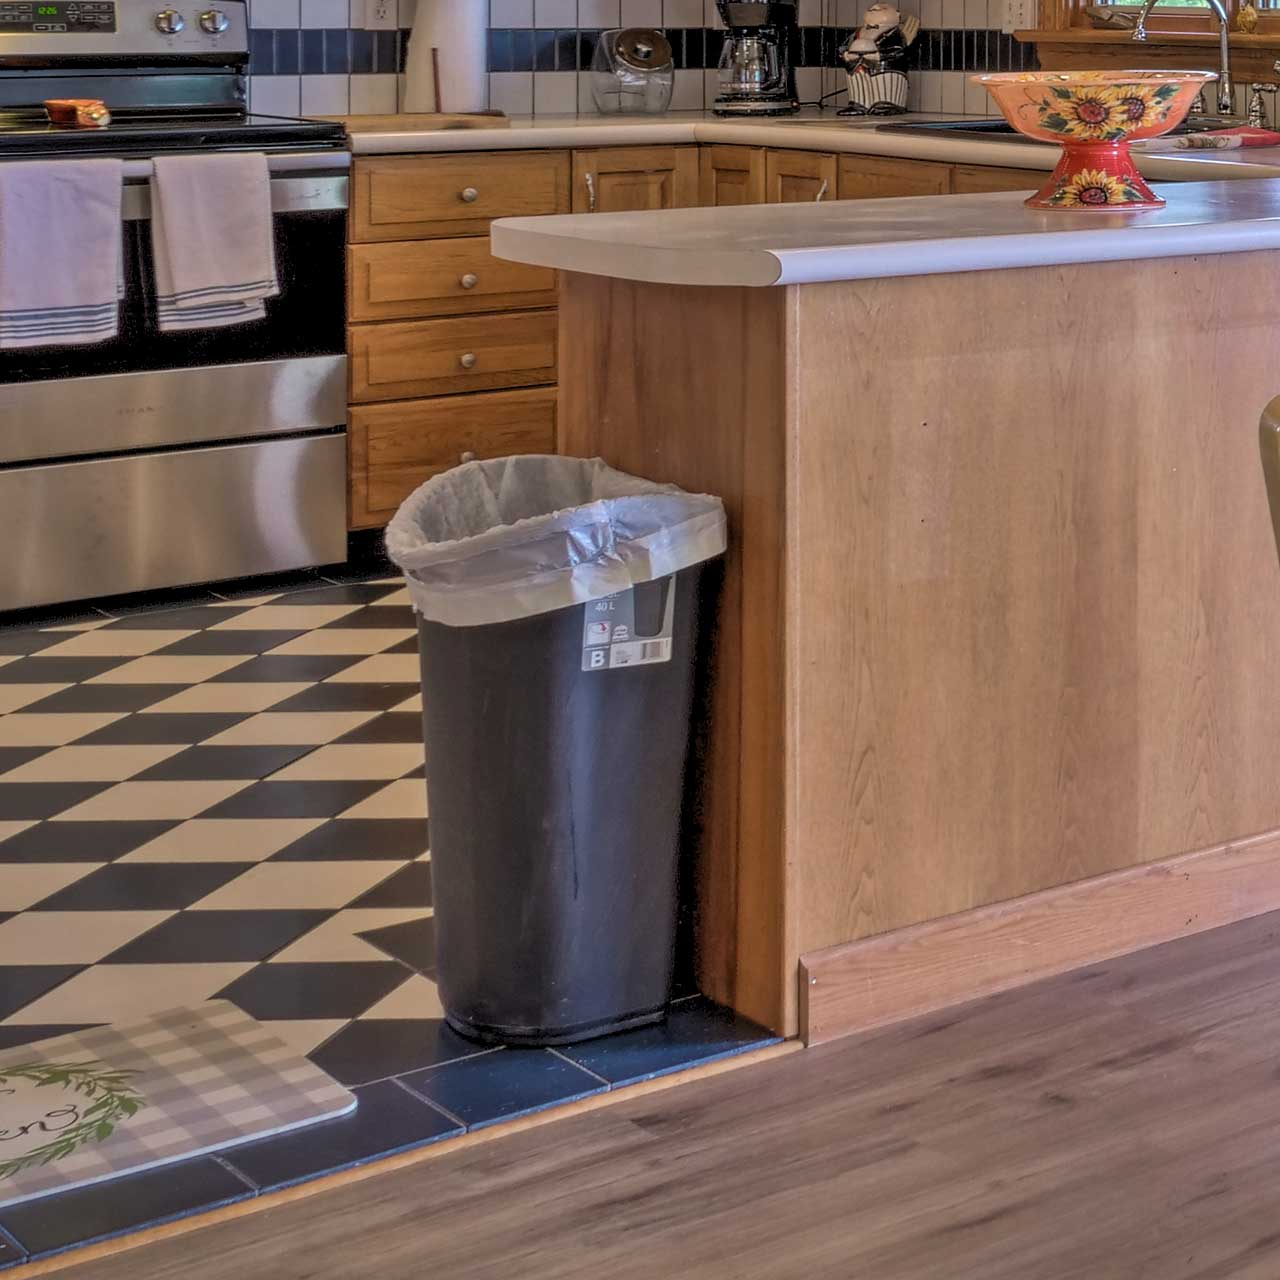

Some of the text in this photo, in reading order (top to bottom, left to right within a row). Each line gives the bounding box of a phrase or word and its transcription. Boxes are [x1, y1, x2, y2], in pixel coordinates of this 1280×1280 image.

[594, 601, 616, 612] 40 L
[591, 650, 605, 668] B
